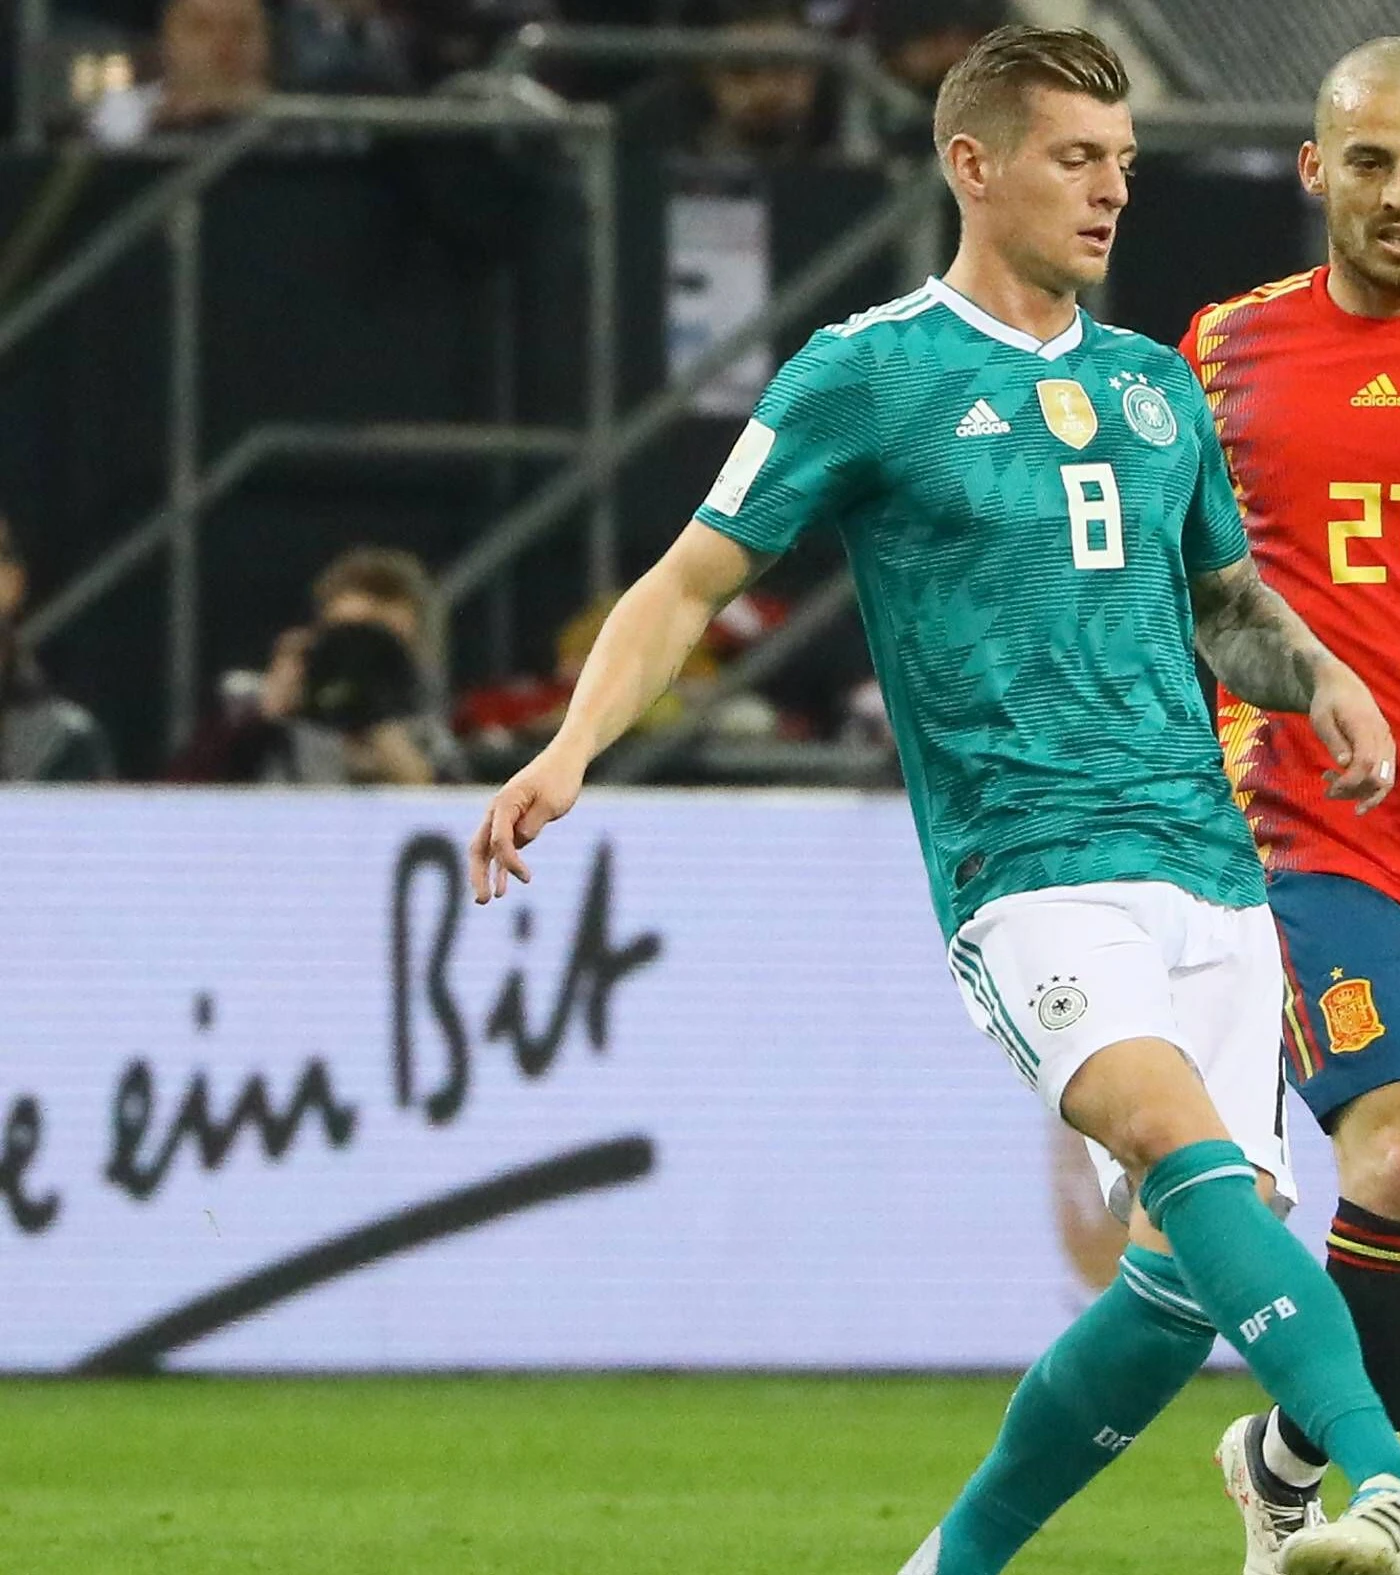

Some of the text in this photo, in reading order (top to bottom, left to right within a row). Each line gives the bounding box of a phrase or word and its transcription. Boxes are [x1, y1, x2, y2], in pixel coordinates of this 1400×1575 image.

[956, 420, 1011, 438] adidas
[1060, 462, 1126, 569] 8
[104, 988, 360, 1200] ein
[392, 830, 665, 1127] Bit
[1239, 1295, 1297, 1344] DFB
[1093, 1425, 1133, 1451] DF
